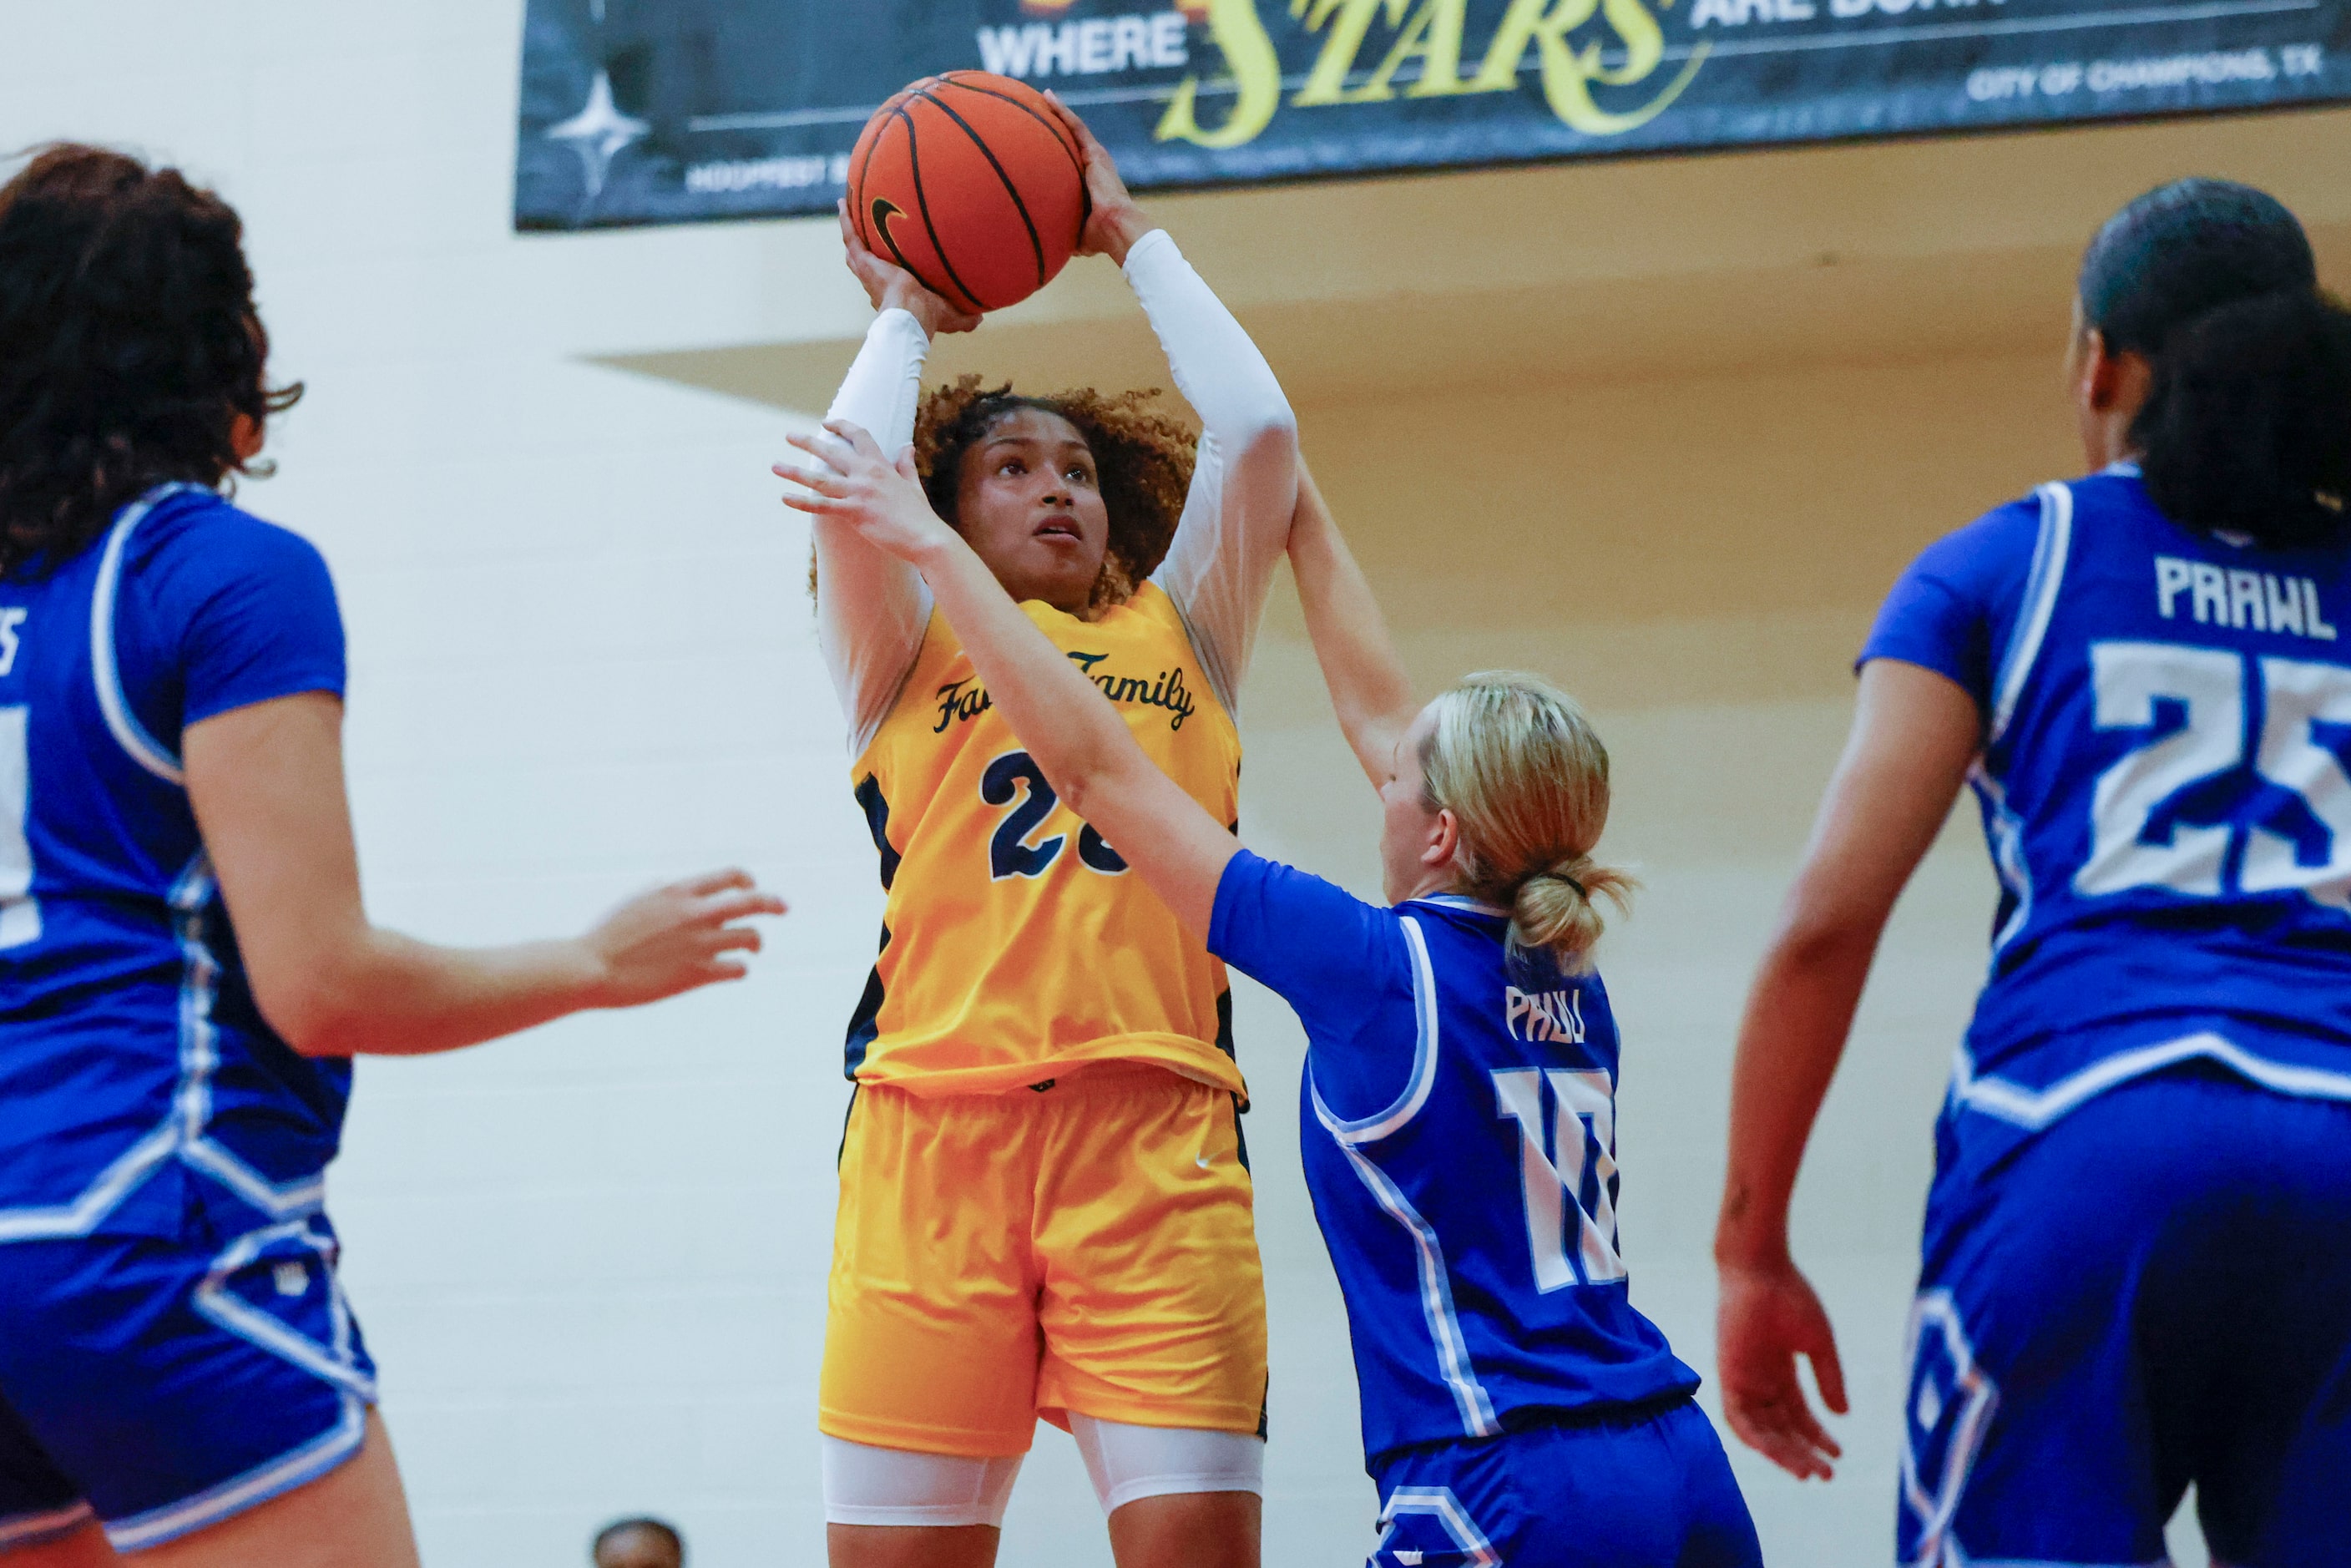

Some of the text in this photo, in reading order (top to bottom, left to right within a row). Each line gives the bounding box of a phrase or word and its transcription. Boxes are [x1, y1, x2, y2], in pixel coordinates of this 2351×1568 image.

[977, 11, 1191, 78] WHERE
[2155, 555, 2338, 641] PRAWL
[2072, 640, 2351, 913] 25
[1489, 1066, 1628, 1295] 10
